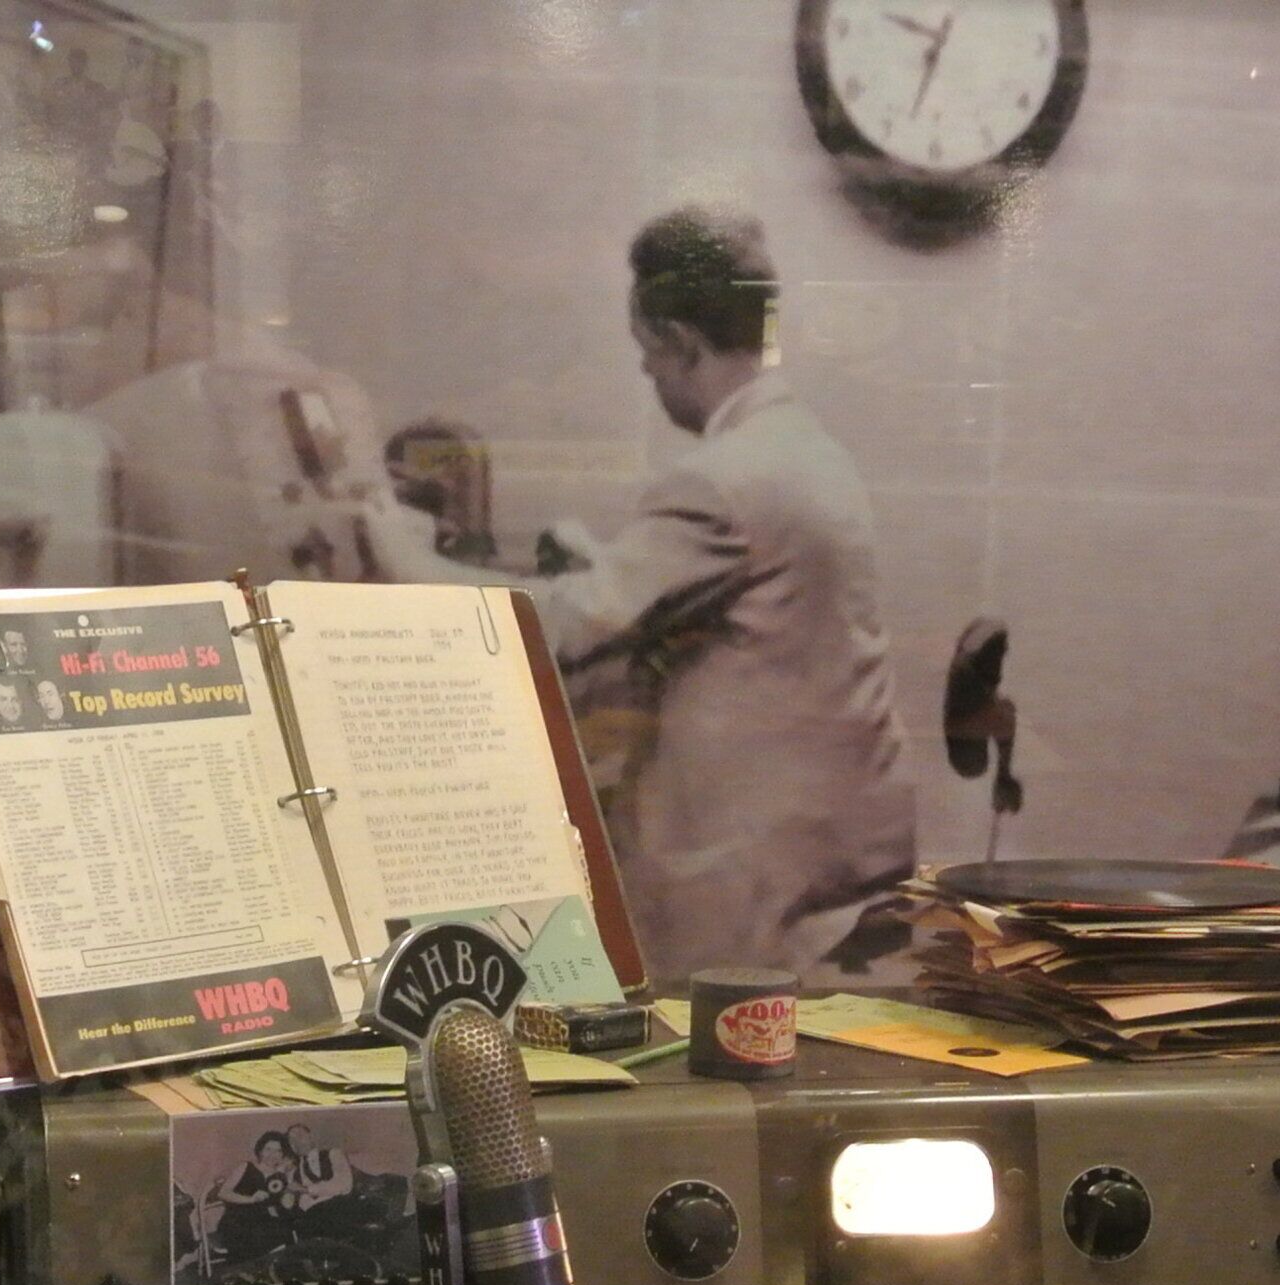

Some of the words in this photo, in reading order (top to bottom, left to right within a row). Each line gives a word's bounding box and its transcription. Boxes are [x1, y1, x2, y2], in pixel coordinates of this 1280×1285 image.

[53, 628, 76, 639] THE
[79, 625, 143, 638] EXCLUSIVE
[60, 654, 107, 677] Hi-Fi
[112, 646, 188, 674] Channel
[195, 645, 221, 668] 56
[69, 689, 108, 716] Top
[111, 685, 177, 711] Record
[182, 683, 245, 706] Survey
[394, 940, 511, 1018] WHBQ
[194, 978, 291, 1021] WHBQ
[78, 1025, 108, 1041] Hear
[111, 1023, 131, 1036] the
[134, 1013, 196, 1033] Difference
[221, 1015, 274, 1035] RADIO
